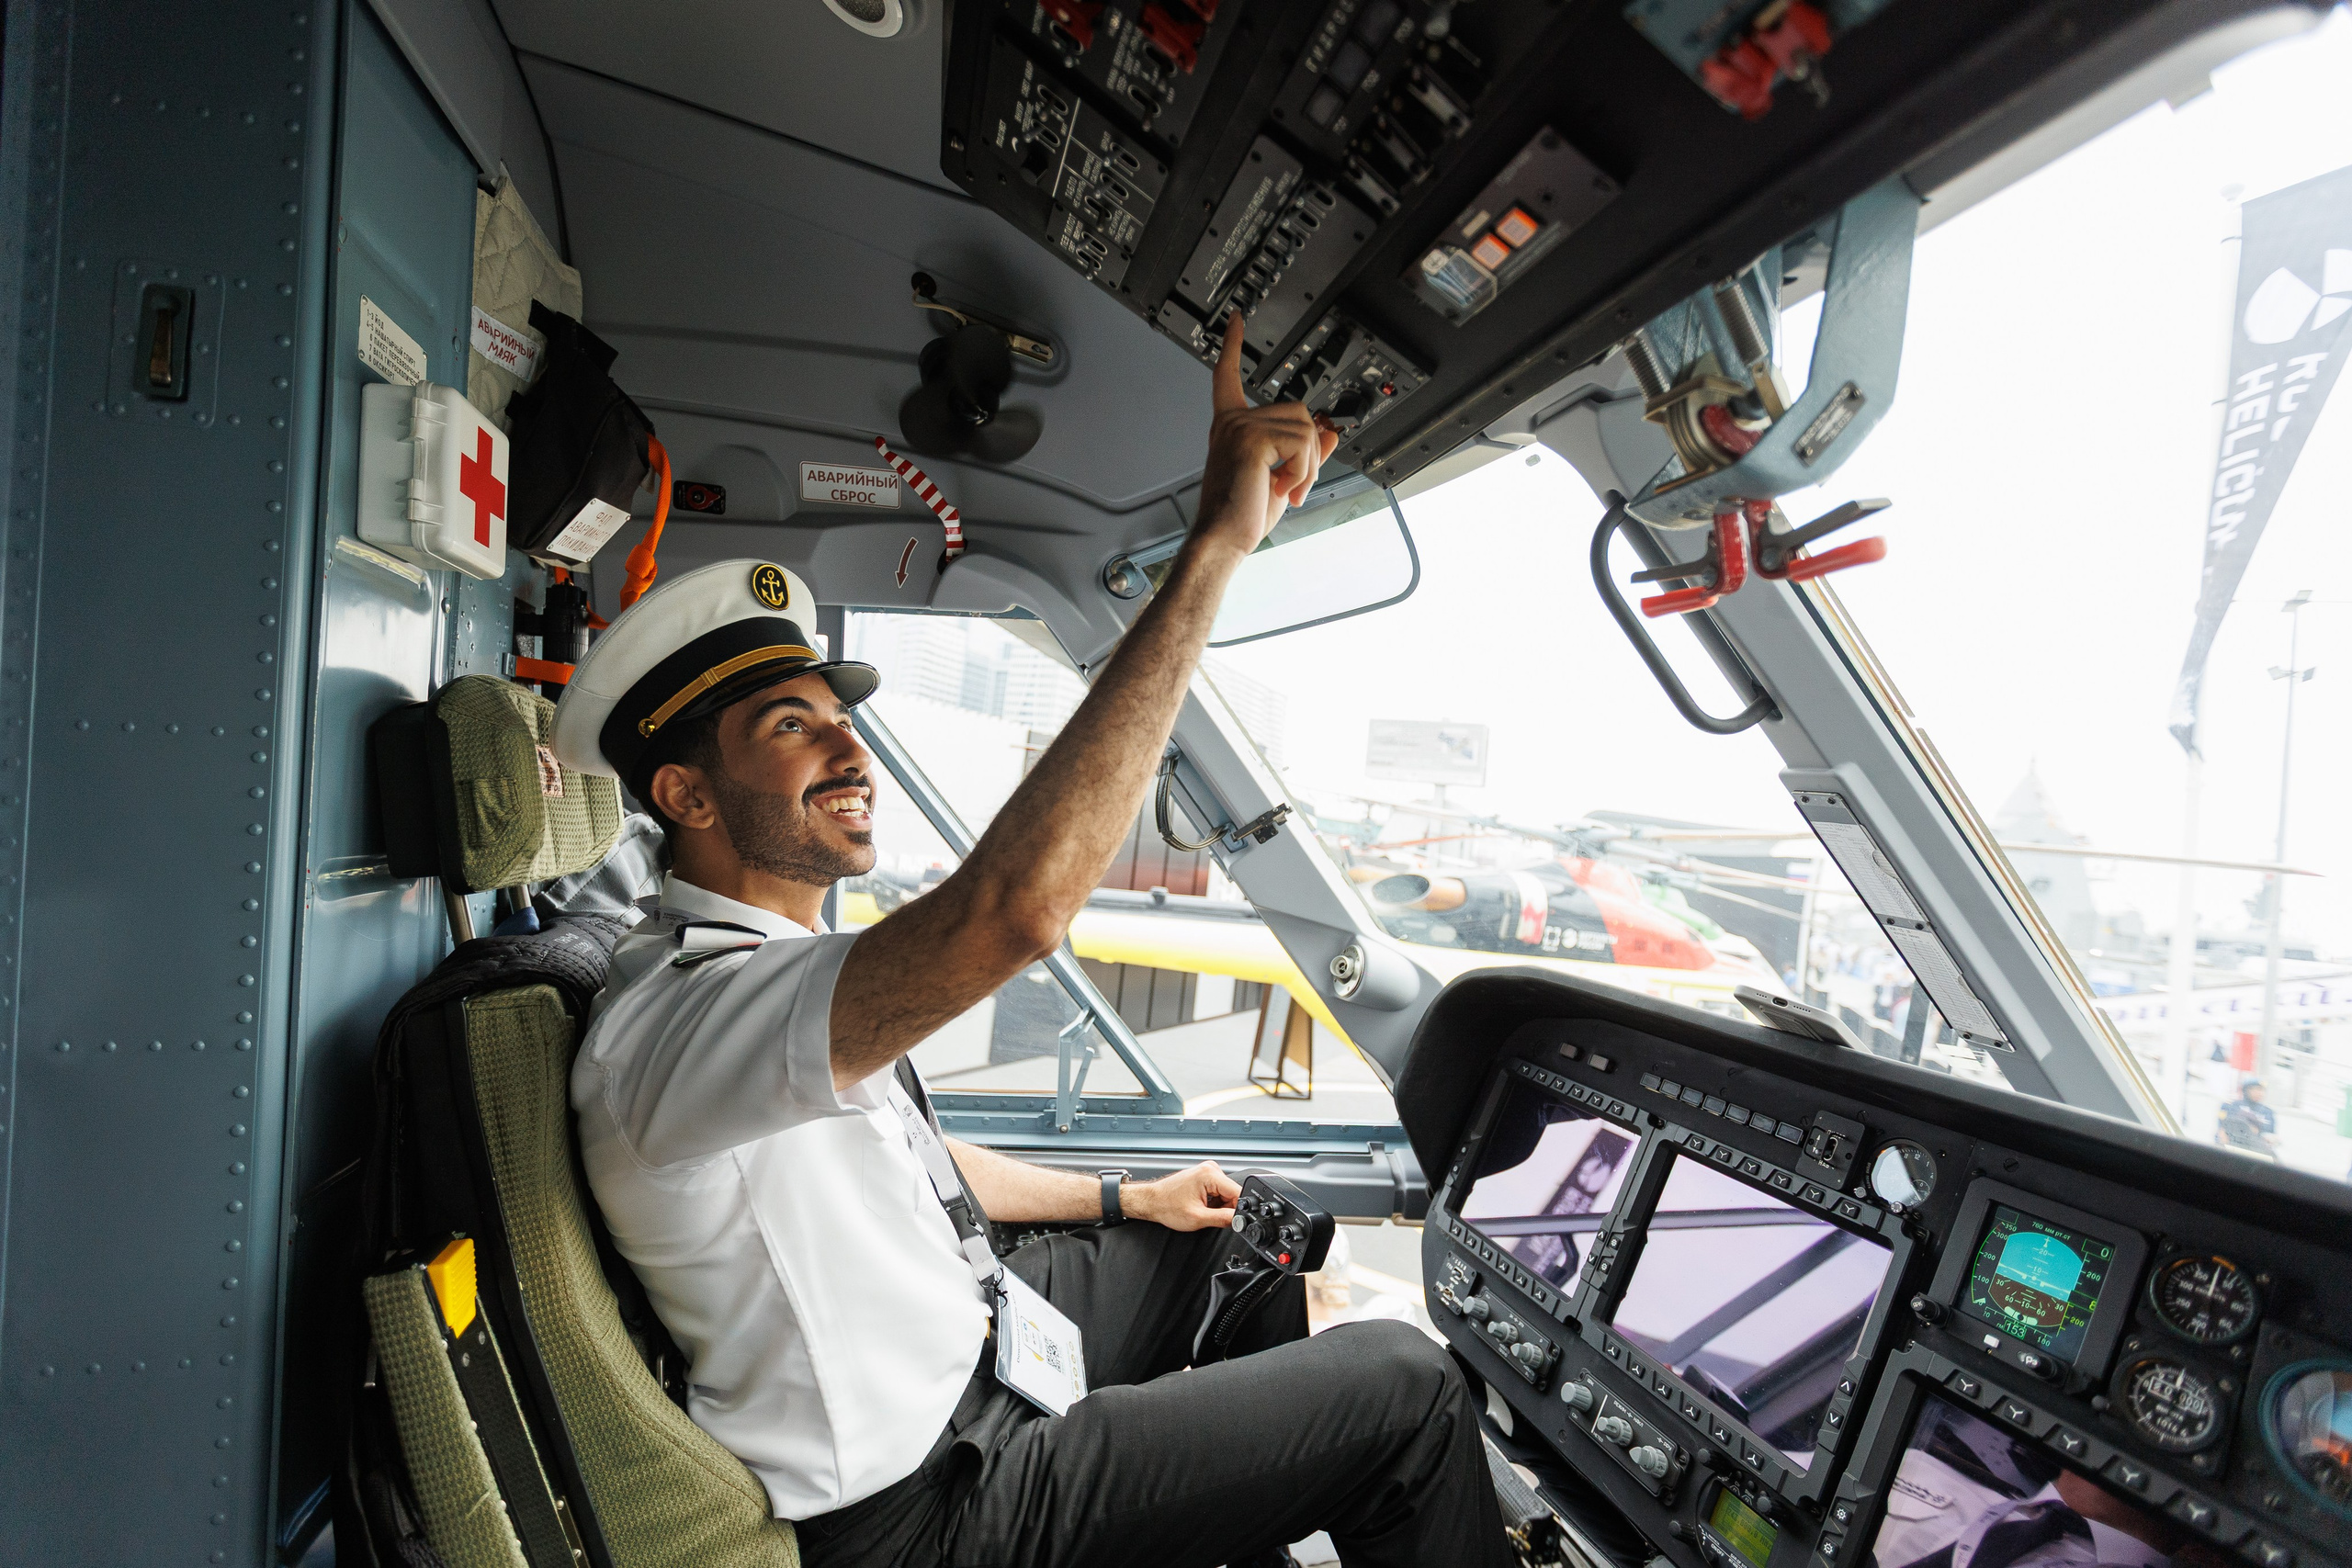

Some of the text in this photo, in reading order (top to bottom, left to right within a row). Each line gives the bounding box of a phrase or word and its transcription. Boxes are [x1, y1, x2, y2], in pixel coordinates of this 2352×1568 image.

[1064, 175, 1078, 199] ТАБЛО
[1204, 254, 1227, 284] СИСТЕМА
[1222, 175, 1273, 254] ЭЛЕКТРОСНАБЖЕНИЯ
[374, 336, 388, 354] ПАКЕТ
[375, 327, 403, 356] НАШАТЫРНЫЙ
[478, 318, 535, 362] АВАРИЙНЫЙ
[488, 341, 517, 367] МАЯК
[807, 469, 898, 490] АВАРИЙНЫЙ
[831, 489, 876, 504] СБРОС
[2004, 1223, 2018, 1232] 350
[2031, 1221, 2043, 1230] 760
[1996, 1231, 2008, 1241] 300
[1983, 1251, 1996, 1261] 200
[2038, 1247, 2048, 1257] 20
[2100, 1247, 2109, 1258] 0
[2032, 1266, 2041, 1274] 10
[1977, 1275, 1990, 1284] 100
[2086, 1271, 2101, 1281] 200
[1996, 1278, 2005, 1286] 30
[2004, 1294, 2014, 1303] 60
[2020, 1301, 2030, 1309] 10
[2054, 1303, 2064, 1312] 30
[2036, 1308, 2046, 1317] 60
[2069, 1317, 2085, 1327] 200
[2006, 1322, 2026, 1338] 153
[2037, 1337, 2051, 1347] 180
